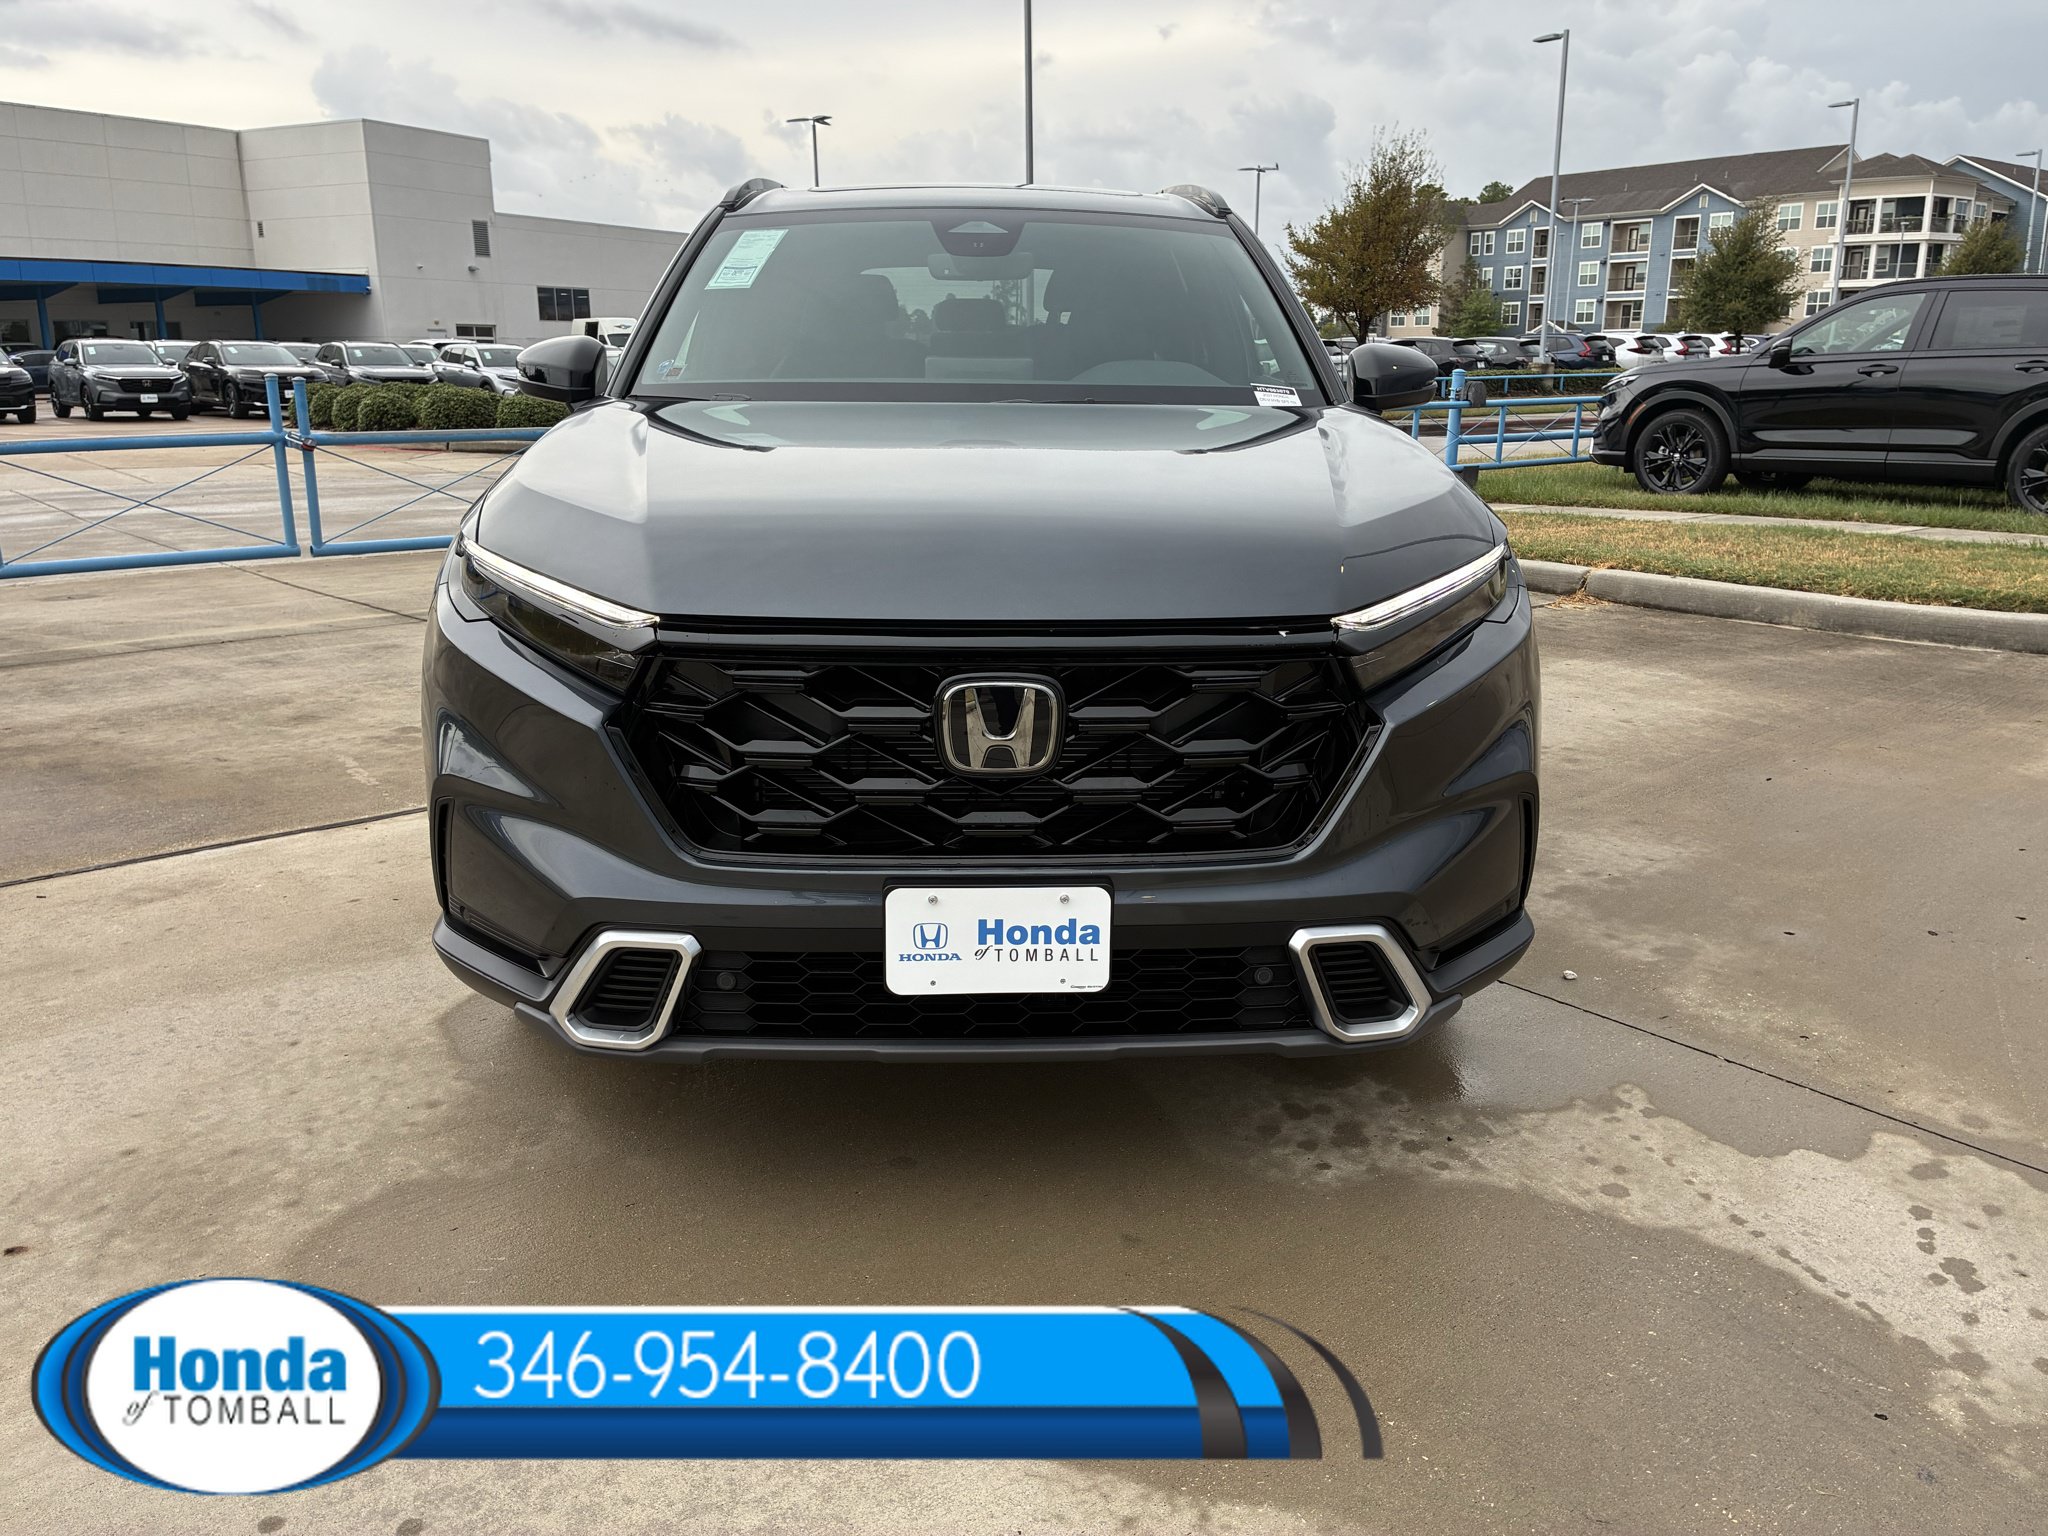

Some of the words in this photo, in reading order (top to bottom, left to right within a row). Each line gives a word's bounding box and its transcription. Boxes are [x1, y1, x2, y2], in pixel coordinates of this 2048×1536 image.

[977, 918, 1101, 945] Honda
[899, 952, 962, 962] HONDA
[974, 944, 993, 961] of
[994, 947, 1099, 962] TOMBALL
